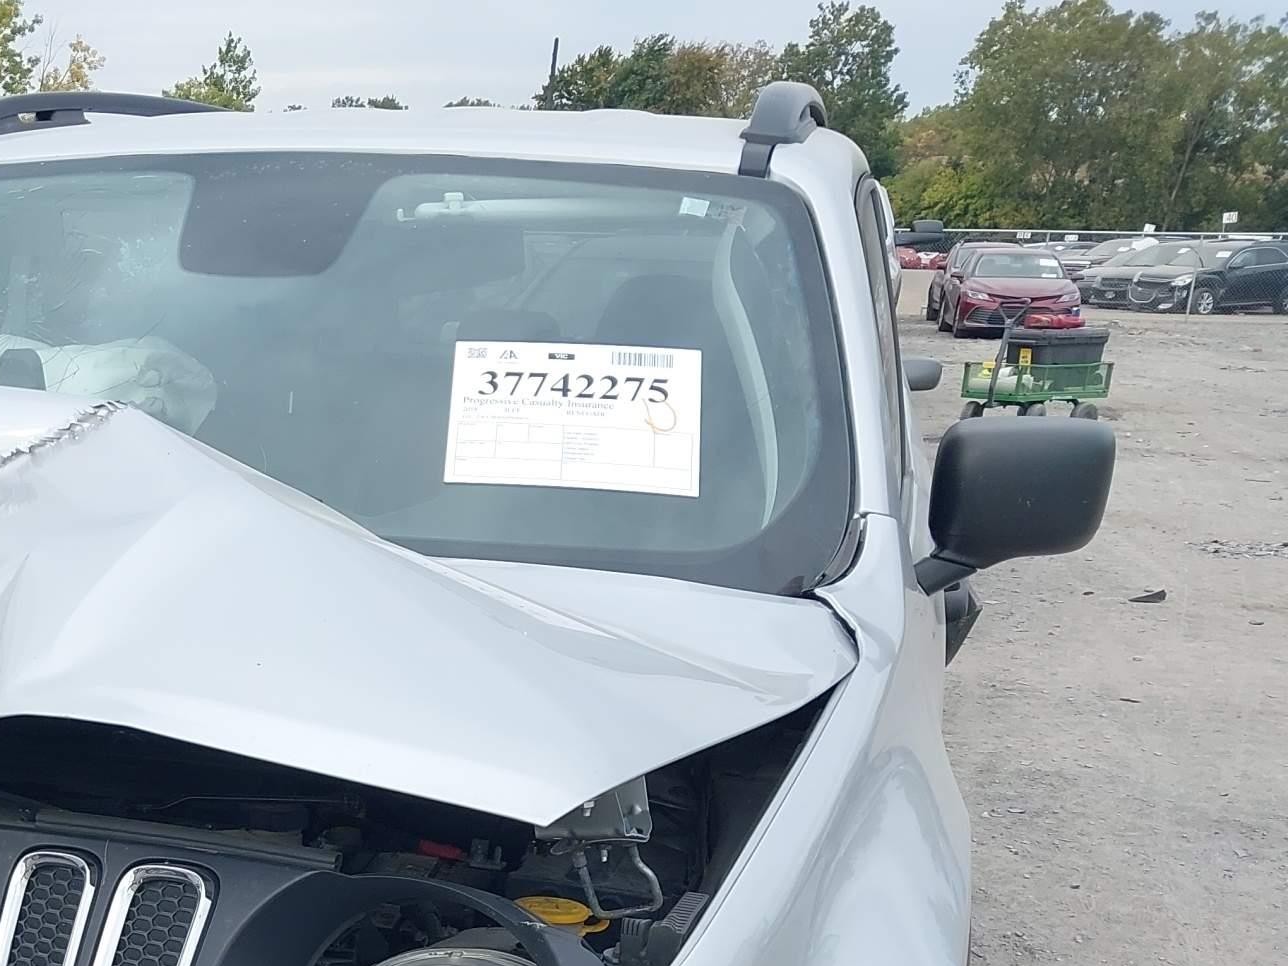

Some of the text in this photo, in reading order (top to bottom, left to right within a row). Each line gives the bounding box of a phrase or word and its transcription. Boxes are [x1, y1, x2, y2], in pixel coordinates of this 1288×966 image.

[478, 370, 669, 403] 37742275
[463, 396, 615, 410] Progressive Casualty Insurance
